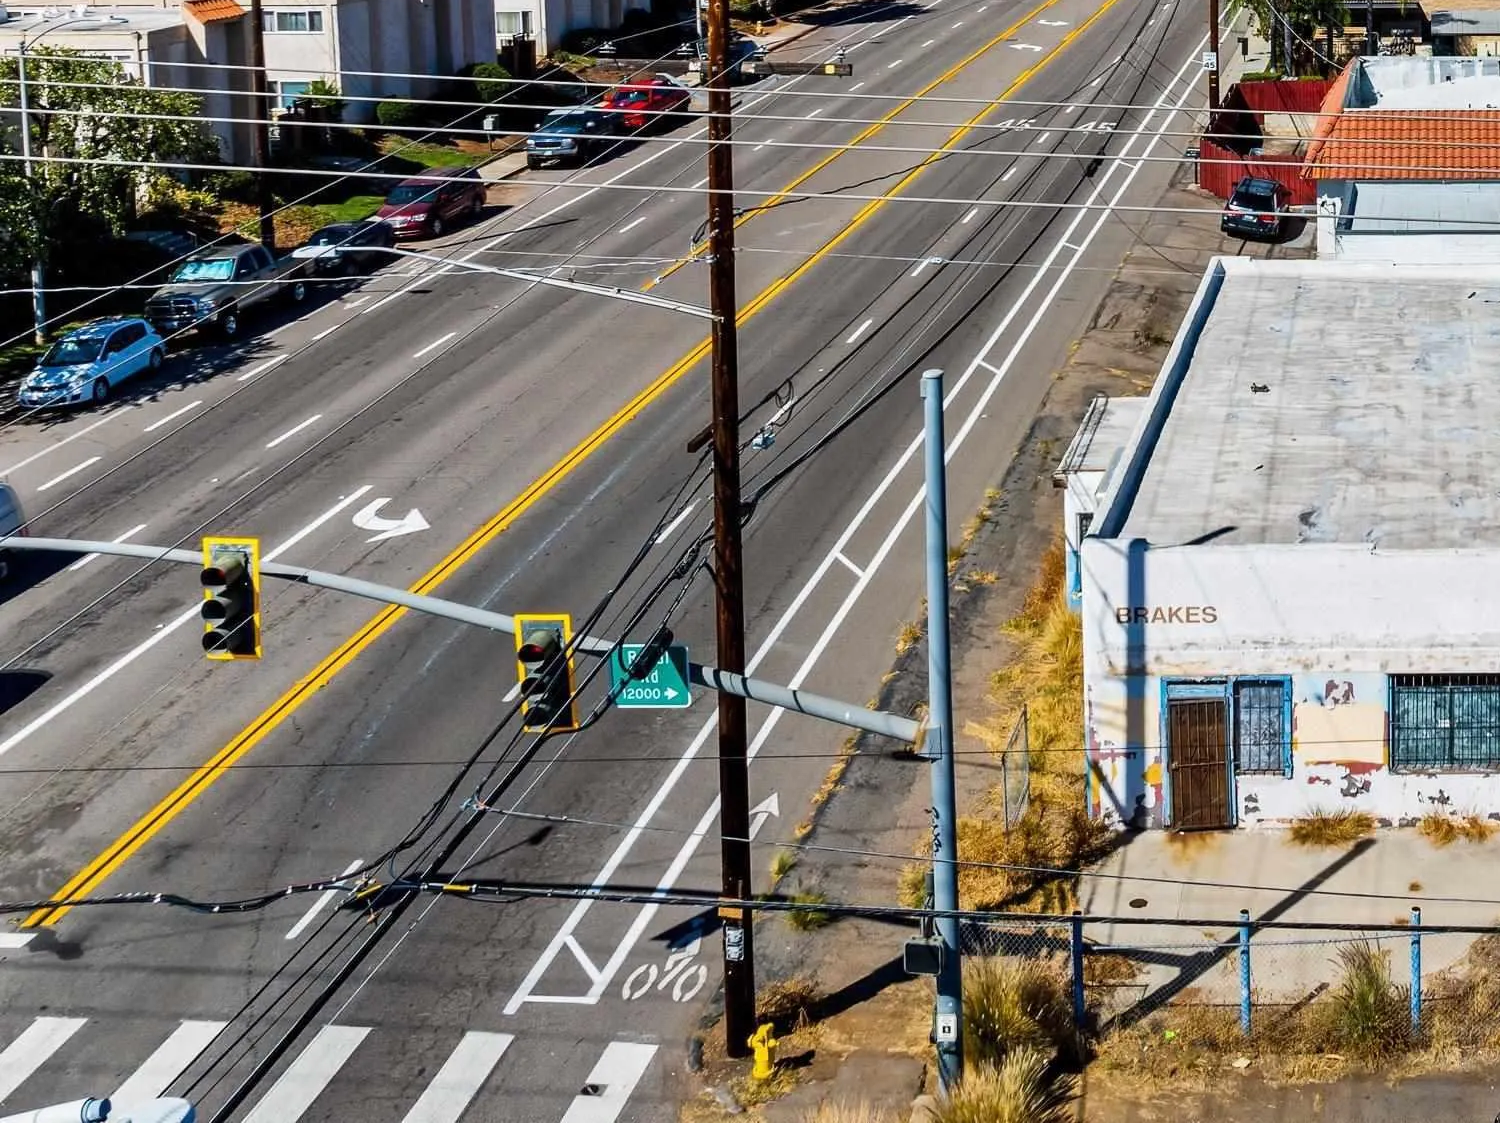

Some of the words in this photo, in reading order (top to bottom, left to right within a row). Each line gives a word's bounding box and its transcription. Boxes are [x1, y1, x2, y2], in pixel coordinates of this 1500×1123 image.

[1203, 61, 1216, 69] 45
[1115, 605, 1218, 625] BRAKES
[622, 687, 661, 700] 12000
